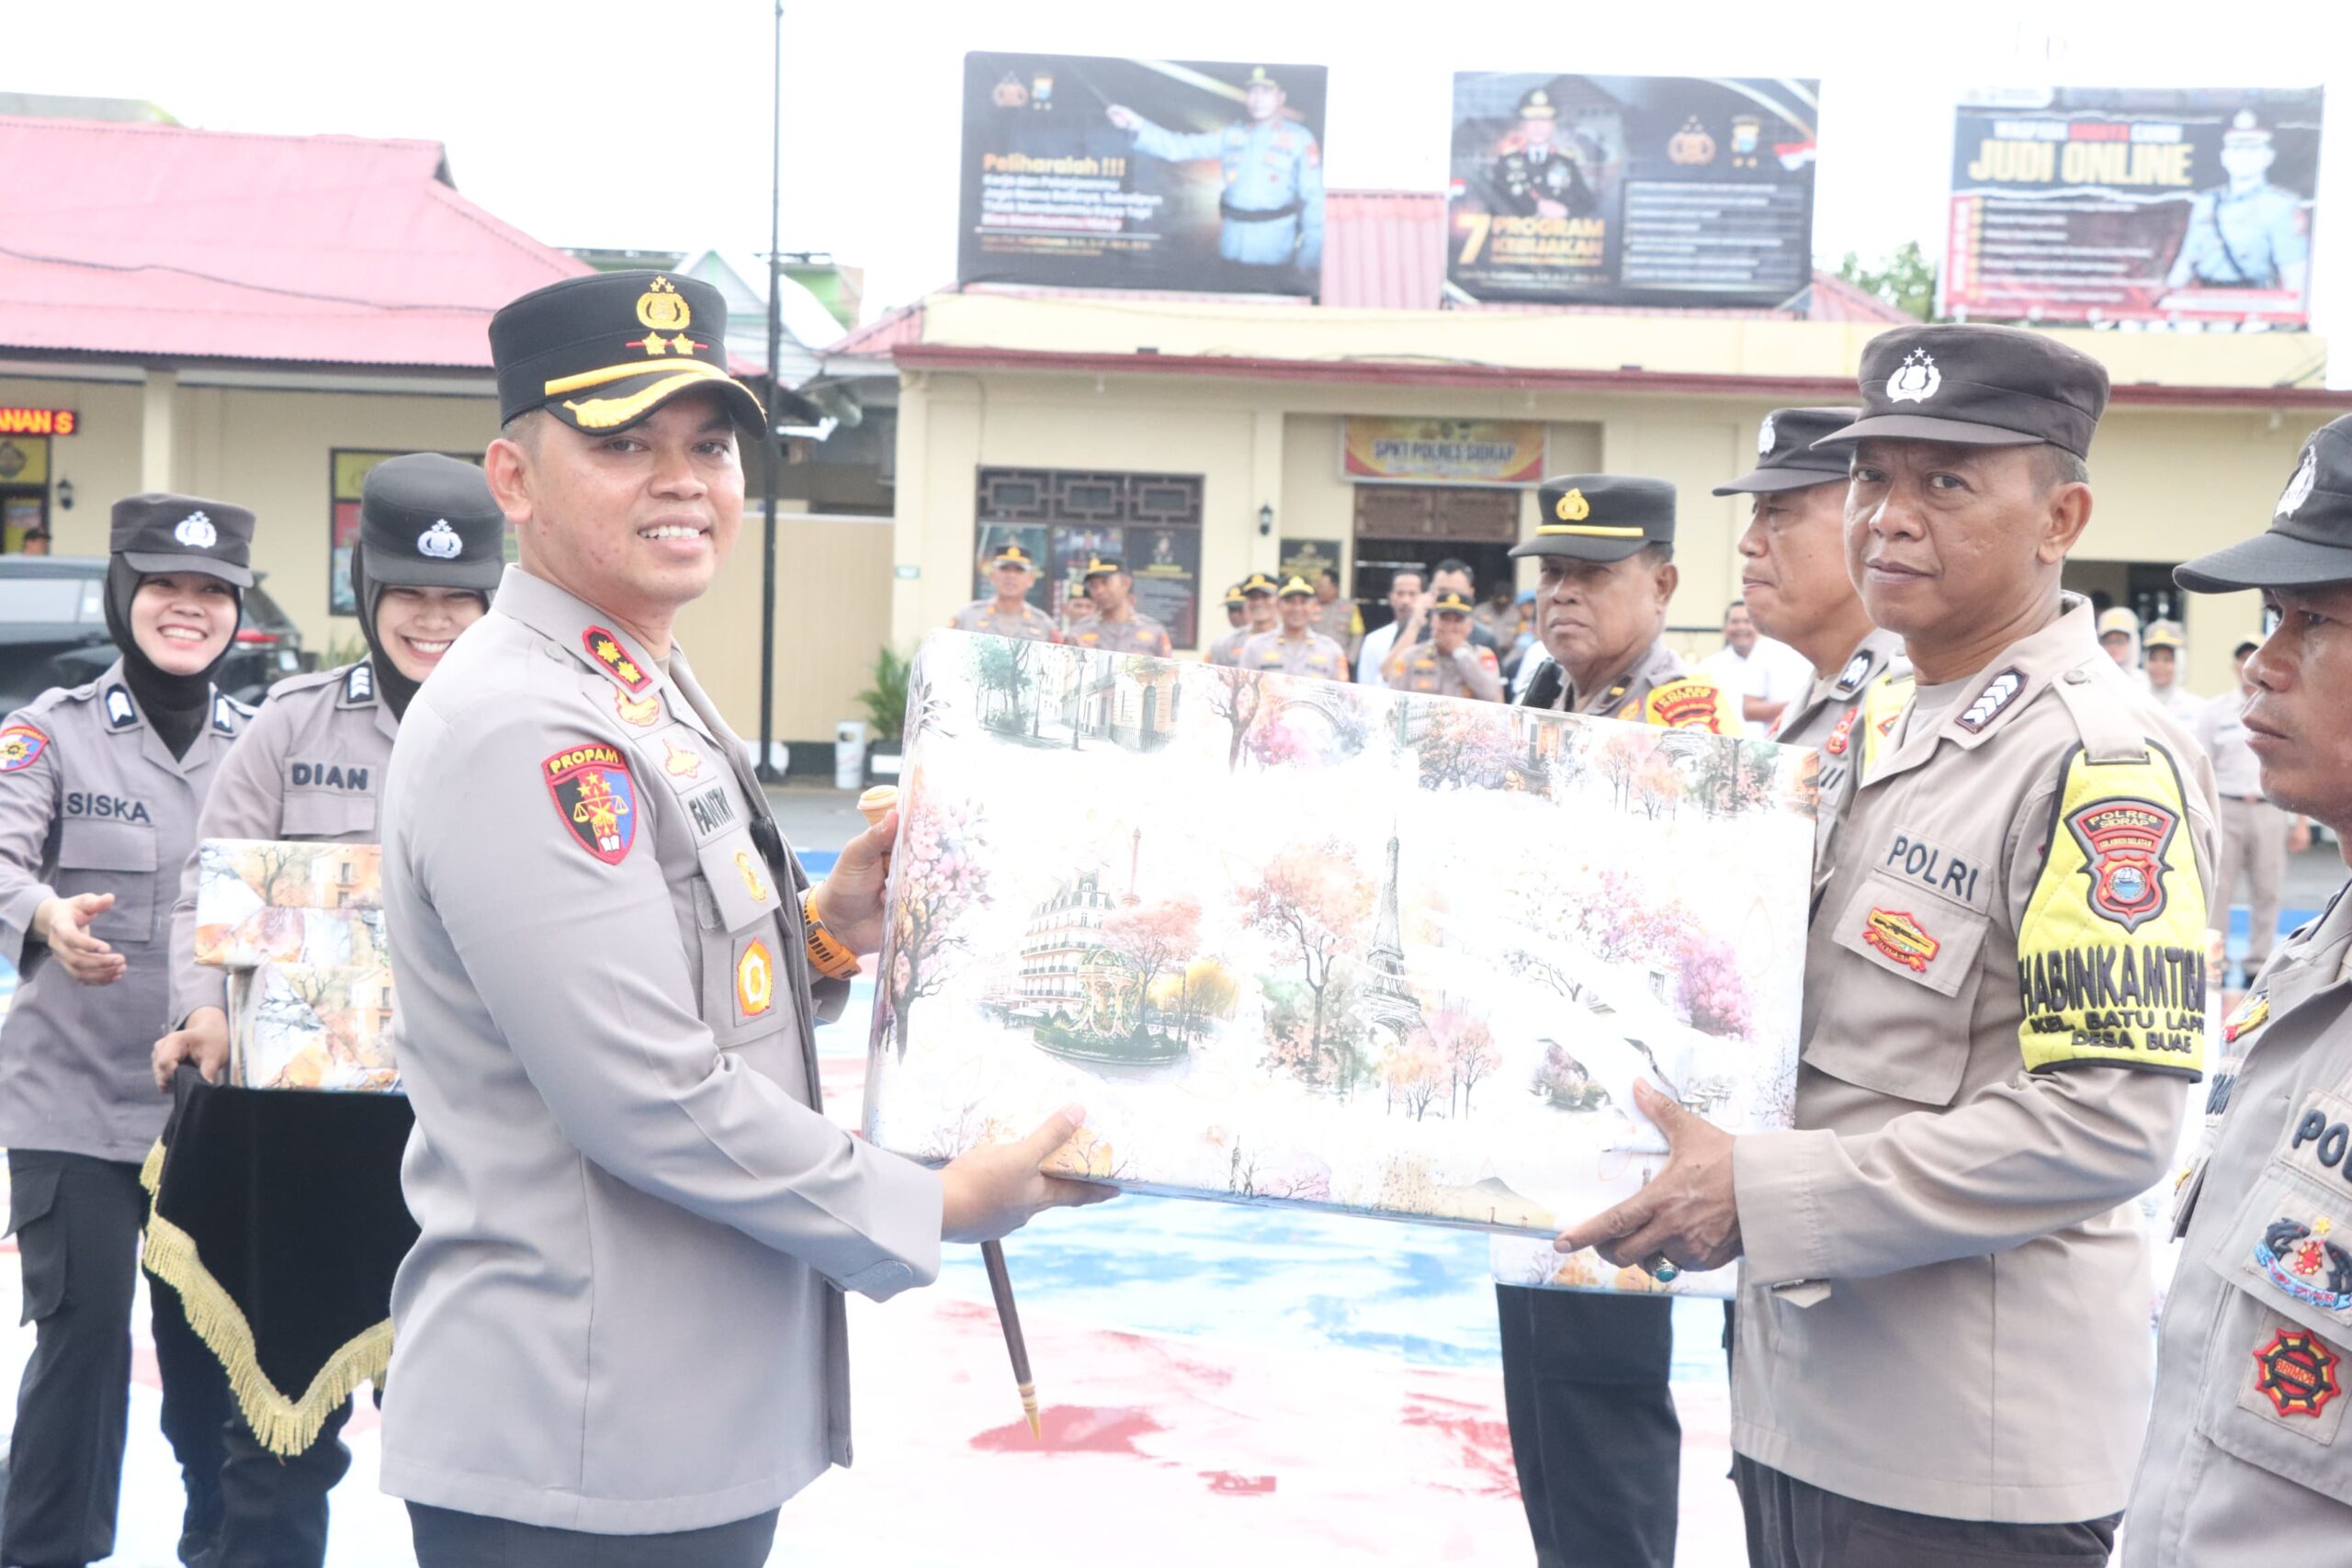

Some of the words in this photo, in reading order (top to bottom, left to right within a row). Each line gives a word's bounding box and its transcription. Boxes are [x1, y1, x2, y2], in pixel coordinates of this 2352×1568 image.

[1969, 139, 2053, 181] JUDI
[2062, 141, 2193, 186] ONLINE
[1457, 213, 1491, 265] 7
[54, 411, 74, 434] S
[549, 748, 619, 774] PROPAM
[291, 762, 368, 790] DIAN
[66, 792, 151, 823] SISKA
[2088, 810, 2158, 826] POLRES
[2098, 818, 2149, 829] SIDRAP
[1887, 835, 1978, 901] POLRI
[2086, 1010, 2155, 1030] BATU
[2072, 1030, 2135, 1050] DESA
[2275, 1358, 2317, 1387] BRIMOB
